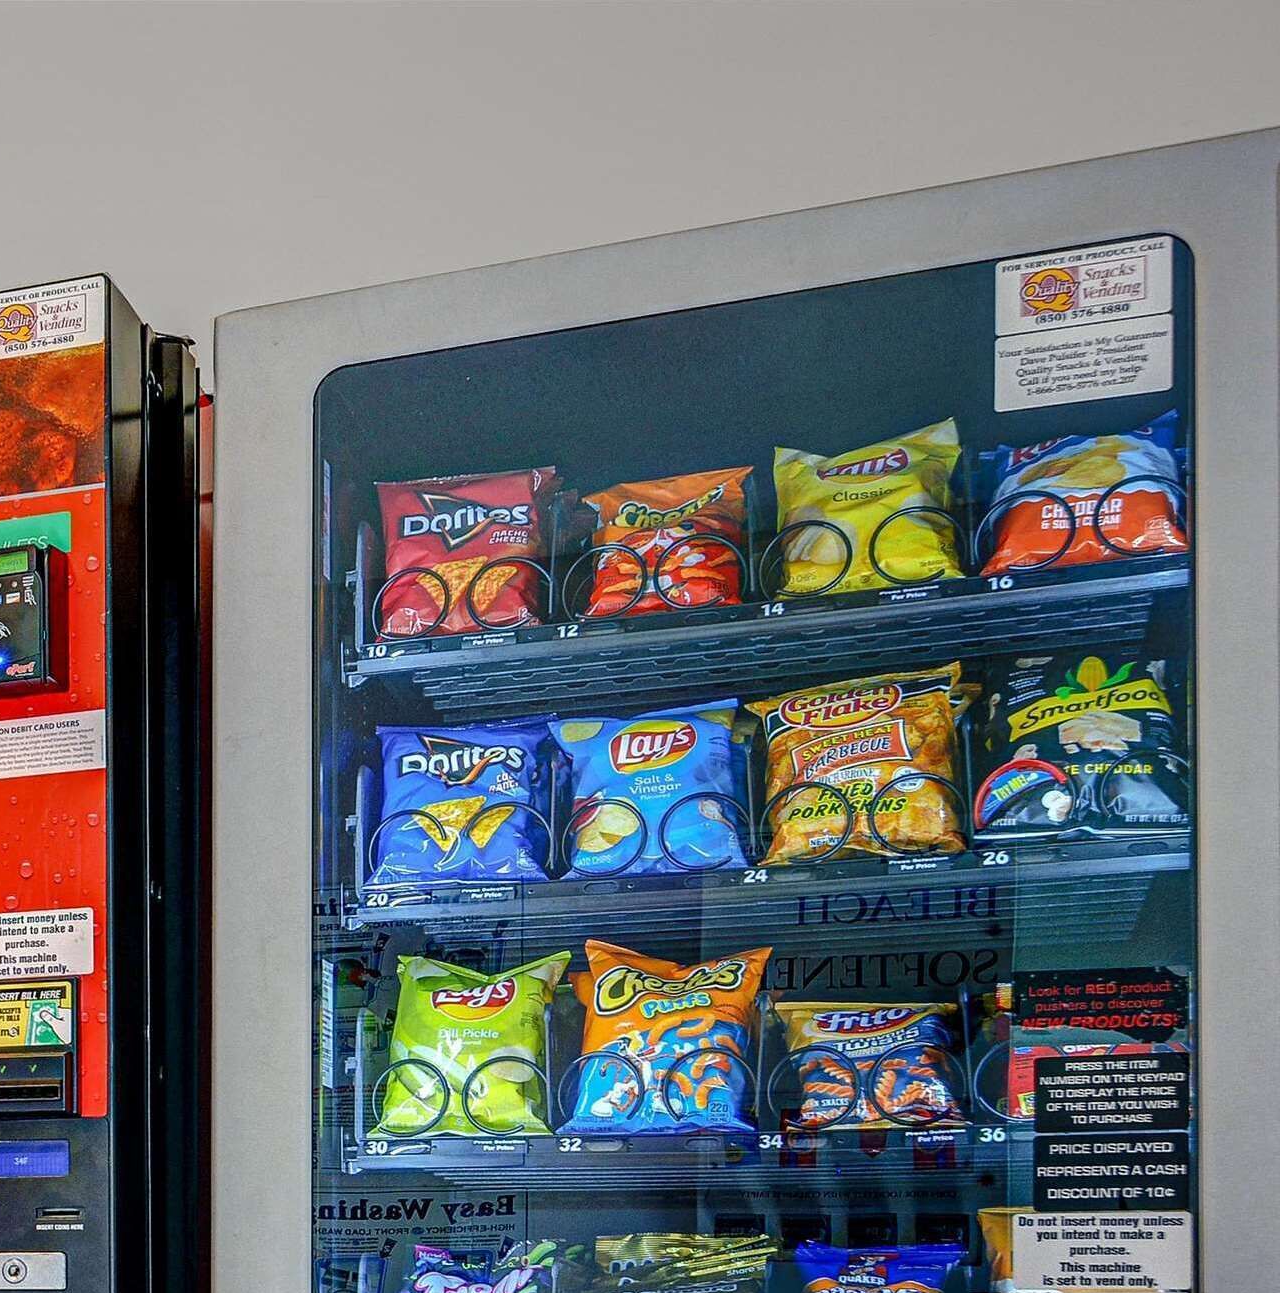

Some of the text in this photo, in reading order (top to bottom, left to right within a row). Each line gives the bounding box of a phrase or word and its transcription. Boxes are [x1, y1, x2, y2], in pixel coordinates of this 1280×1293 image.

[1082, 262, 1136, 281] Snacks
[81, 281, 100, 291] CALL
[1021, 279, 1081, 300] Quality
[1082, 282, 1142, 300] Vending
[39, 300, 79, 315] Snacks
[39, 316, 83, 332] Vending
[4, 335, 74, 354] (850) 576-4880
[831, 487, 899, 504] Classic
[1041, 498, 1123, 519] CHEDDAR
[402, 503, 531, 537] Doritos
[488, 535, 529, 545] CHEESE
[491, 529, 529, 539] NACHO
[988, 575, 1014, 590] 16
[760, 602, 785, 618] 14
[556, 624, 579, 638] 12
[365, 644, 388, 659] 10
[789, 685, 892, 712] Golden
[801, 696, 893, 726] Flake
[11, 725, 33, 734] DEBIT
[33, 722, 55, 732] CARD
[56, 719, 80, 729] USERS
[617, 728, 692, 765] Lay's
[802, 725, 893, 761] SWEET HEAT
[400, 746, 527, 778] Doritos
[805, 736, 891, 781] BARBECUE
[634, 773, 674, 786] Salt &
[628, 782, 682, 795] Vinegar
[788, 802, 842, 821] PORK
[982, 850, 1009, 865] 26
[743, 870, 769, 883] 24
[366, 893, 389, 907] 20
[21, 989, 62, 1000] BILL HERE
[596, 965, 744, 1014] Cheetos
[1028, 980, 1171, 998] Look for RED product
[1035, 998, 1164, 1014] pushers to discover
[1069, 1013, 1178, 1029] PRODUCTS!
[439, 1028, 500, 1039] Dill Pickle
[1065, 1059, 1159, 1072] PRESS THE ITEM
[1039, 1072, 1185, 1086] NUMBER ON THE KEYPAD
[1048, 1086, 1177, 1099] TO DISPLAY THE PRICE
[710, 1103, 729, 1113] 220
[1046, 1099, 1179, 1113] OF THE ITEM YOU WISH
[1070, 1113, 1154, 1125] TO PURCHASE
[758, 1135, 784, 1149] 34
[979, 1128, 1006, 1143] 36
[365, 1141, 389, 1155] 30
[558, 1138, 582, 1152] 32
[1018, 1216, 1184, 1231] Do not insert money unless
[1036, 1229, 1165, 1242] you intend to make a
[1069, 1245, 1131, 1257] purchase.
[1059, 1262, 1141, 1273] This machine
[838, 1275, 886, 1286] QUAKER
[1042, 1275, 1158, 1289] is set to vend only.
